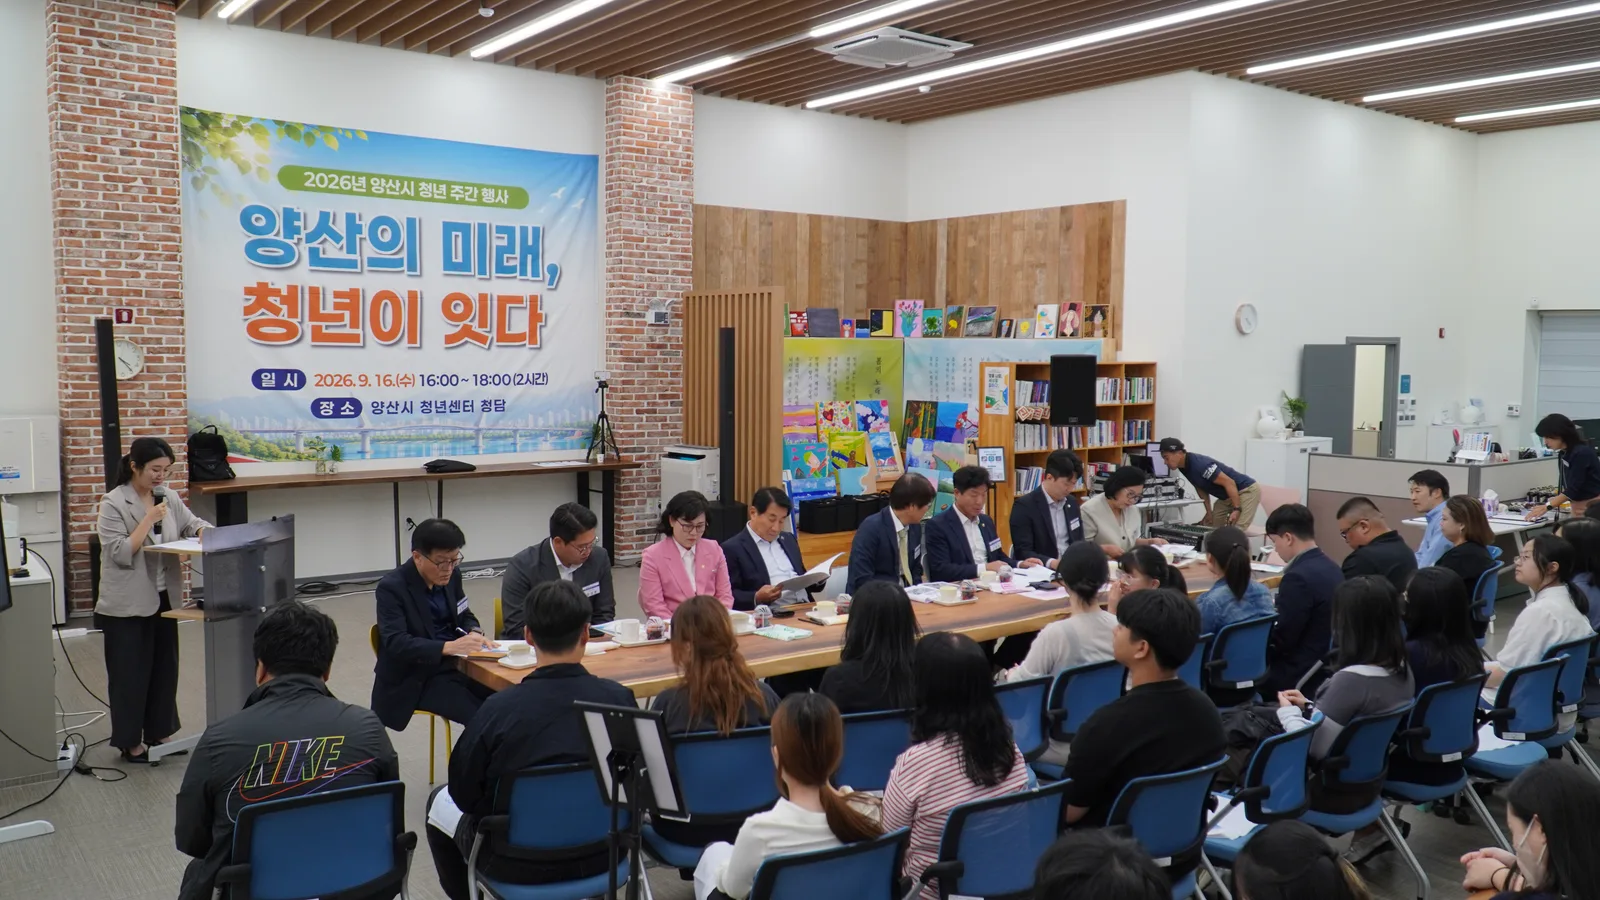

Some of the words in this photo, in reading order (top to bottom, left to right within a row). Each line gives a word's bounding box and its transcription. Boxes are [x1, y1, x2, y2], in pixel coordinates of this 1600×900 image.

[303, 171, 367, 193] 2026년
[370, 177, 415, 197] 양산시
[418, 181, 447, 200] 청년
[450, 184, 479, 202] 주간
[481, 187, 509, 205] 행사
[238, 203, 420, 275] 양산의
[440, 219, 561, 289] 미래,
[242, 281, 420, 348] 청년이
[440, 291, 546, 349] 잇다
[370, 400, 414, 415] 양산시
[420, 399, 475, 414] 청년센터
[480, 399, 507, 413] 청담
[243, 735, 345, 788] NIKE
